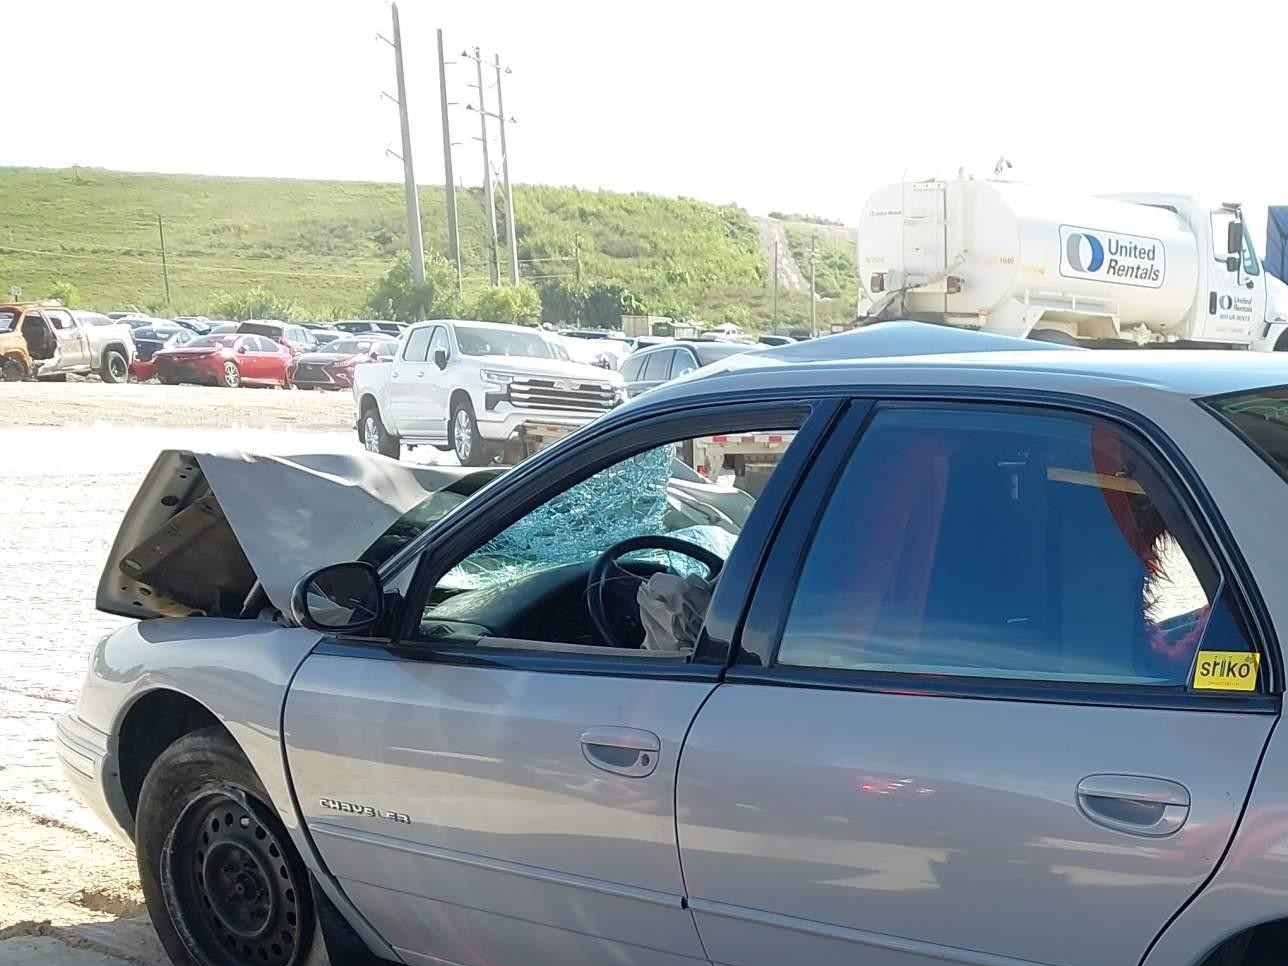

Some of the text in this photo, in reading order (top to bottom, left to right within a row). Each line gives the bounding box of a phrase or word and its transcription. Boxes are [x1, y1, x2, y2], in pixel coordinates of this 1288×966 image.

[1108, 238, 1156, 261] United
[1106, 258, 1160, 282] Rentals
[1233, 296, 1252, 305] United
[319, 798, 411, 825] CHRYSLER
